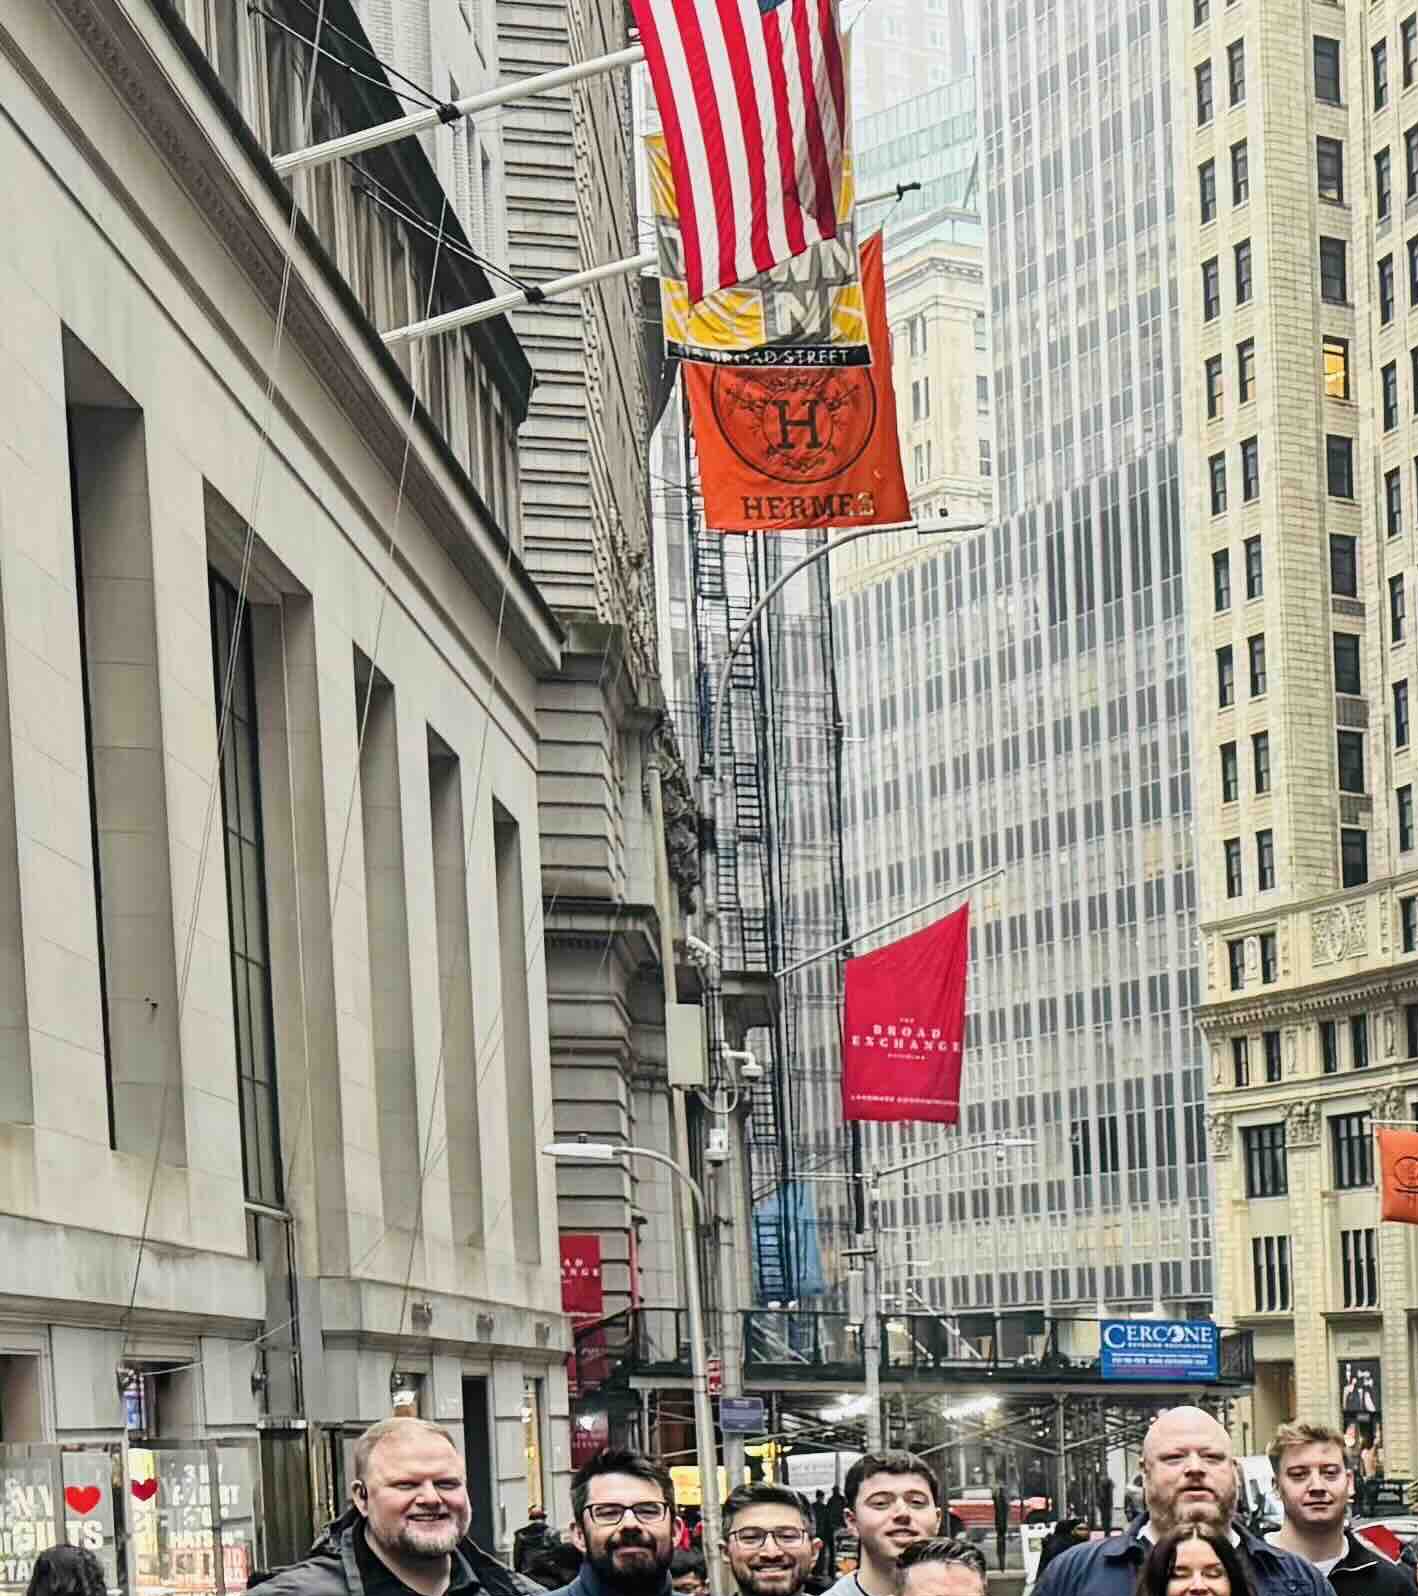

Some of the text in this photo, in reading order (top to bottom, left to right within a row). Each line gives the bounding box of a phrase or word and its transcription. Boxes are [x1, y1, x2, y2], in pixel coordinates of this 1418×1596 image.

[780, 349, 849, 365] STREET
[873, 1024, 941, 1039] BROAD
[852, 1035, 960, 1052] EXCHANGE
